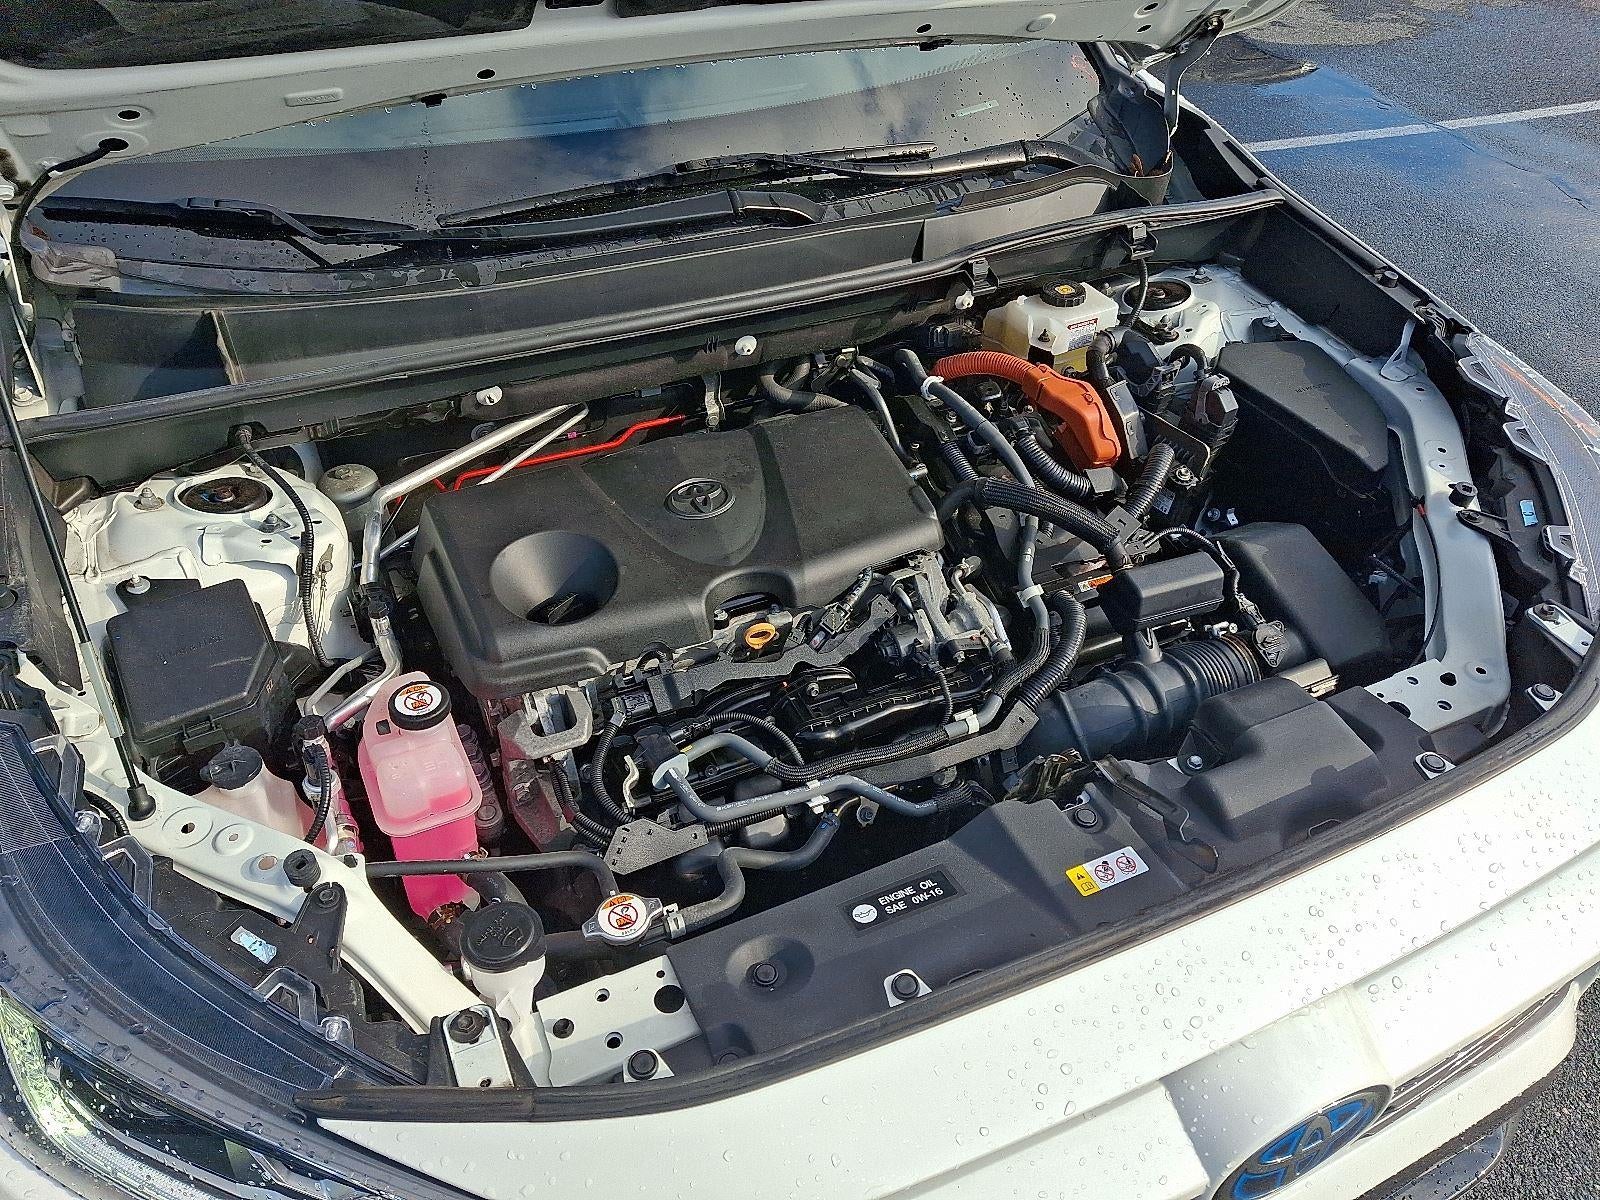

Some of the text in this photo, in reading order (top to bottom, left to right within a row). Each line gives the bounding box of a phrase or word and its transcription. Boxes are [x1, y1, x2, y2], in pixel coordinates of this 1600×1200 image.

[877, 879, 938, 906] ENGINE OIL
[884, 887, 944, 914] SAE 0W-16
